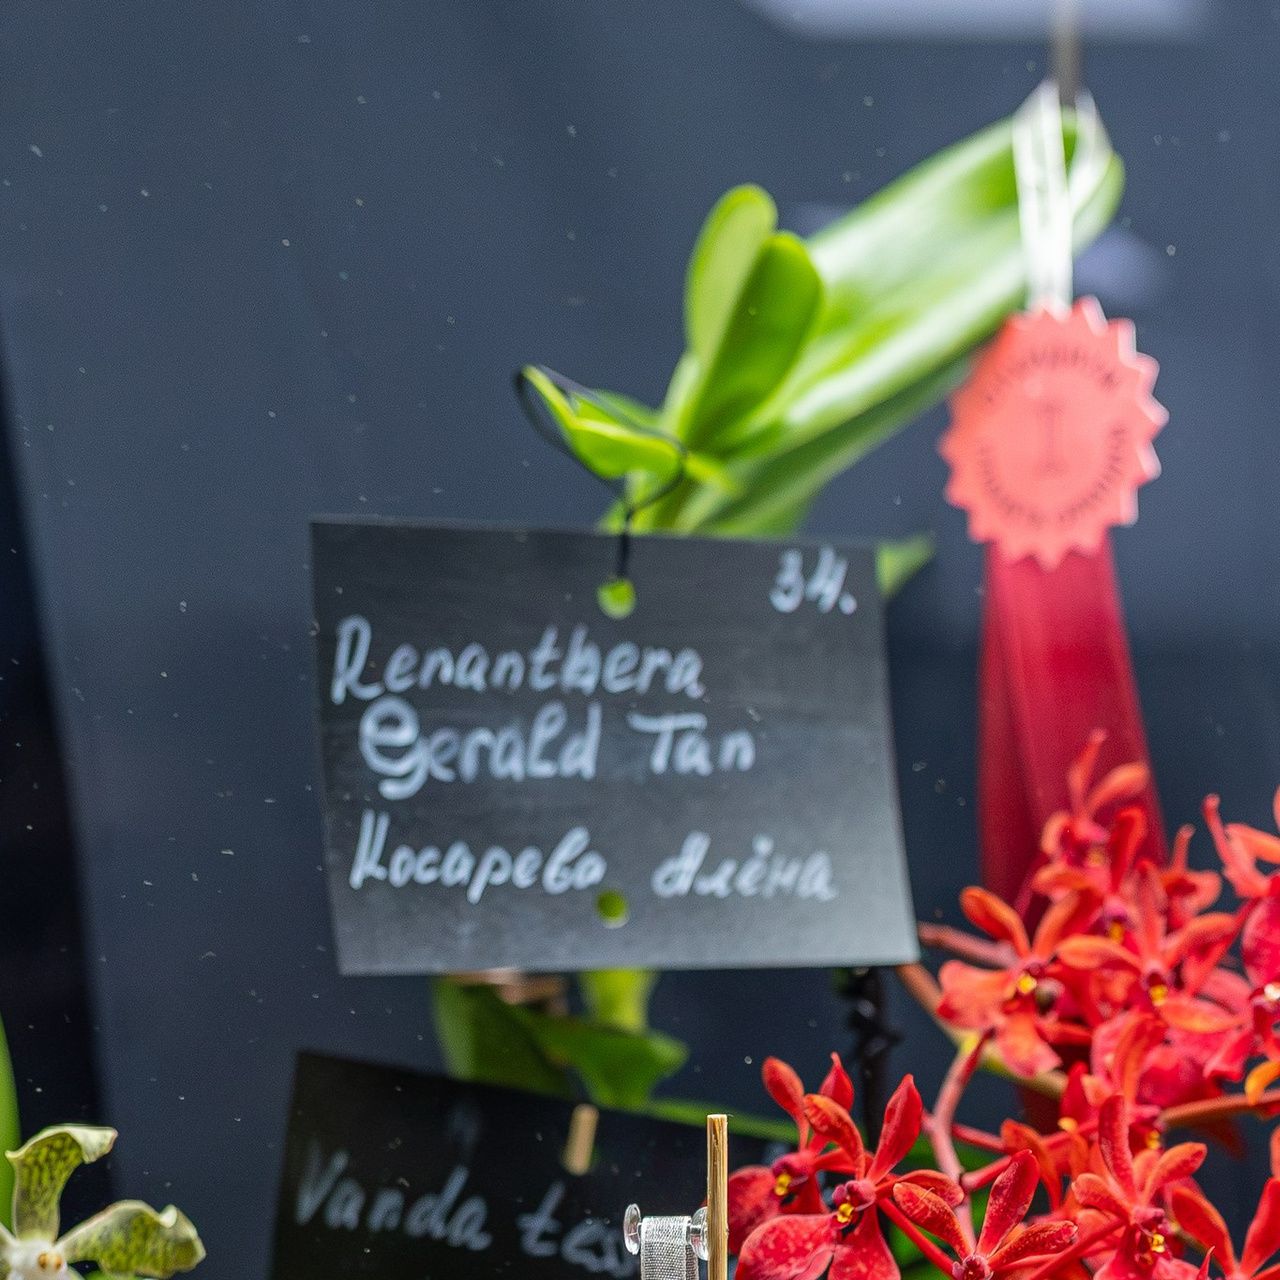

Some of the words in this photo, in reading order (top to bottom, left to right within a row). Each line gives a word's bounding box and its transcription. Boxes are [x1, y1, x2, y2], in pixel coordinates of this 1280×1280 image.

[331, 613, 706, 703] Renanthera
[361, 699, 603, 799] Gerald
[627, 711, 757, 776] Tan
[297, 1143, 492, 1250] Vanda
